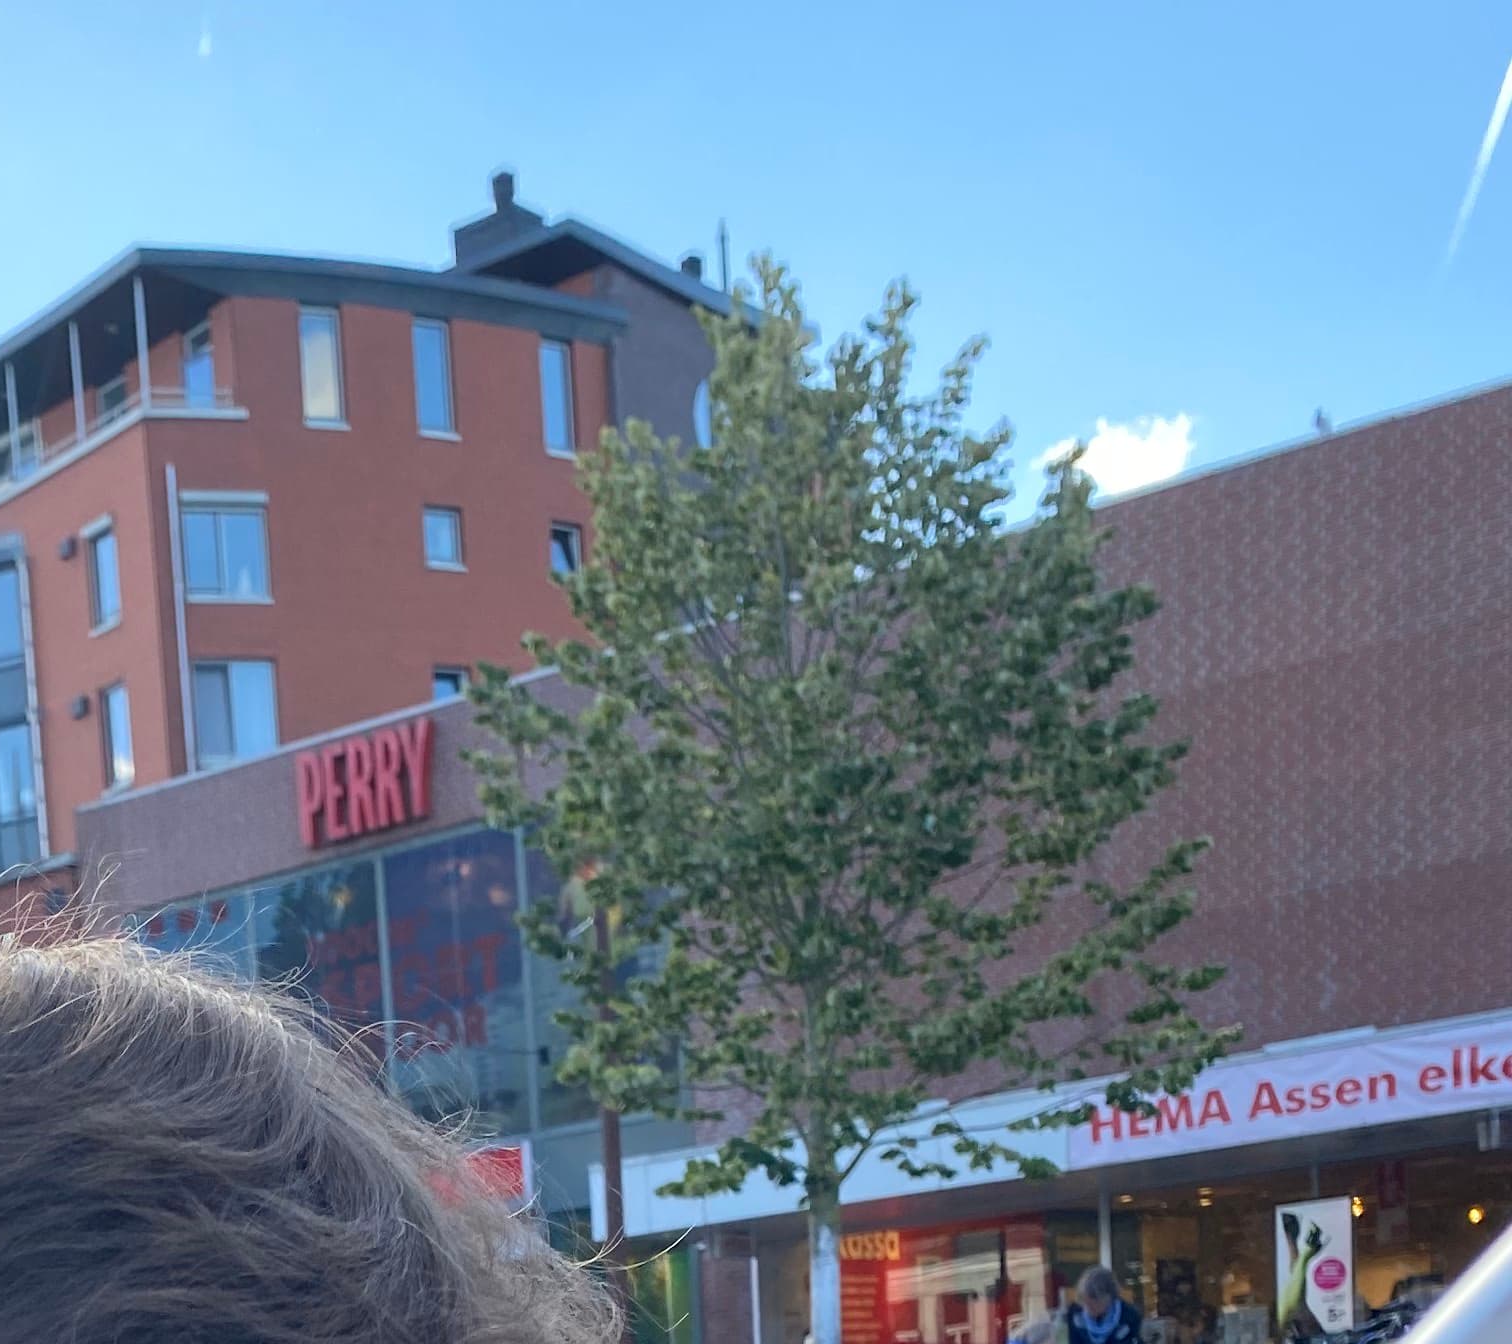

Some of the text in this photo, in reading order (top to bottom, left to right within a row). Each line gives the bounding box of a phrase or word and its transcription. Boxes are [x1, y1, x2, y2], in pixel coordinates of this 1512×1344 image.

[295, 715, 433, 851] PERRY
[1090, 1089, 1232, 1144] HEMA
[1249, 1070, 1396, 1121] Assen
